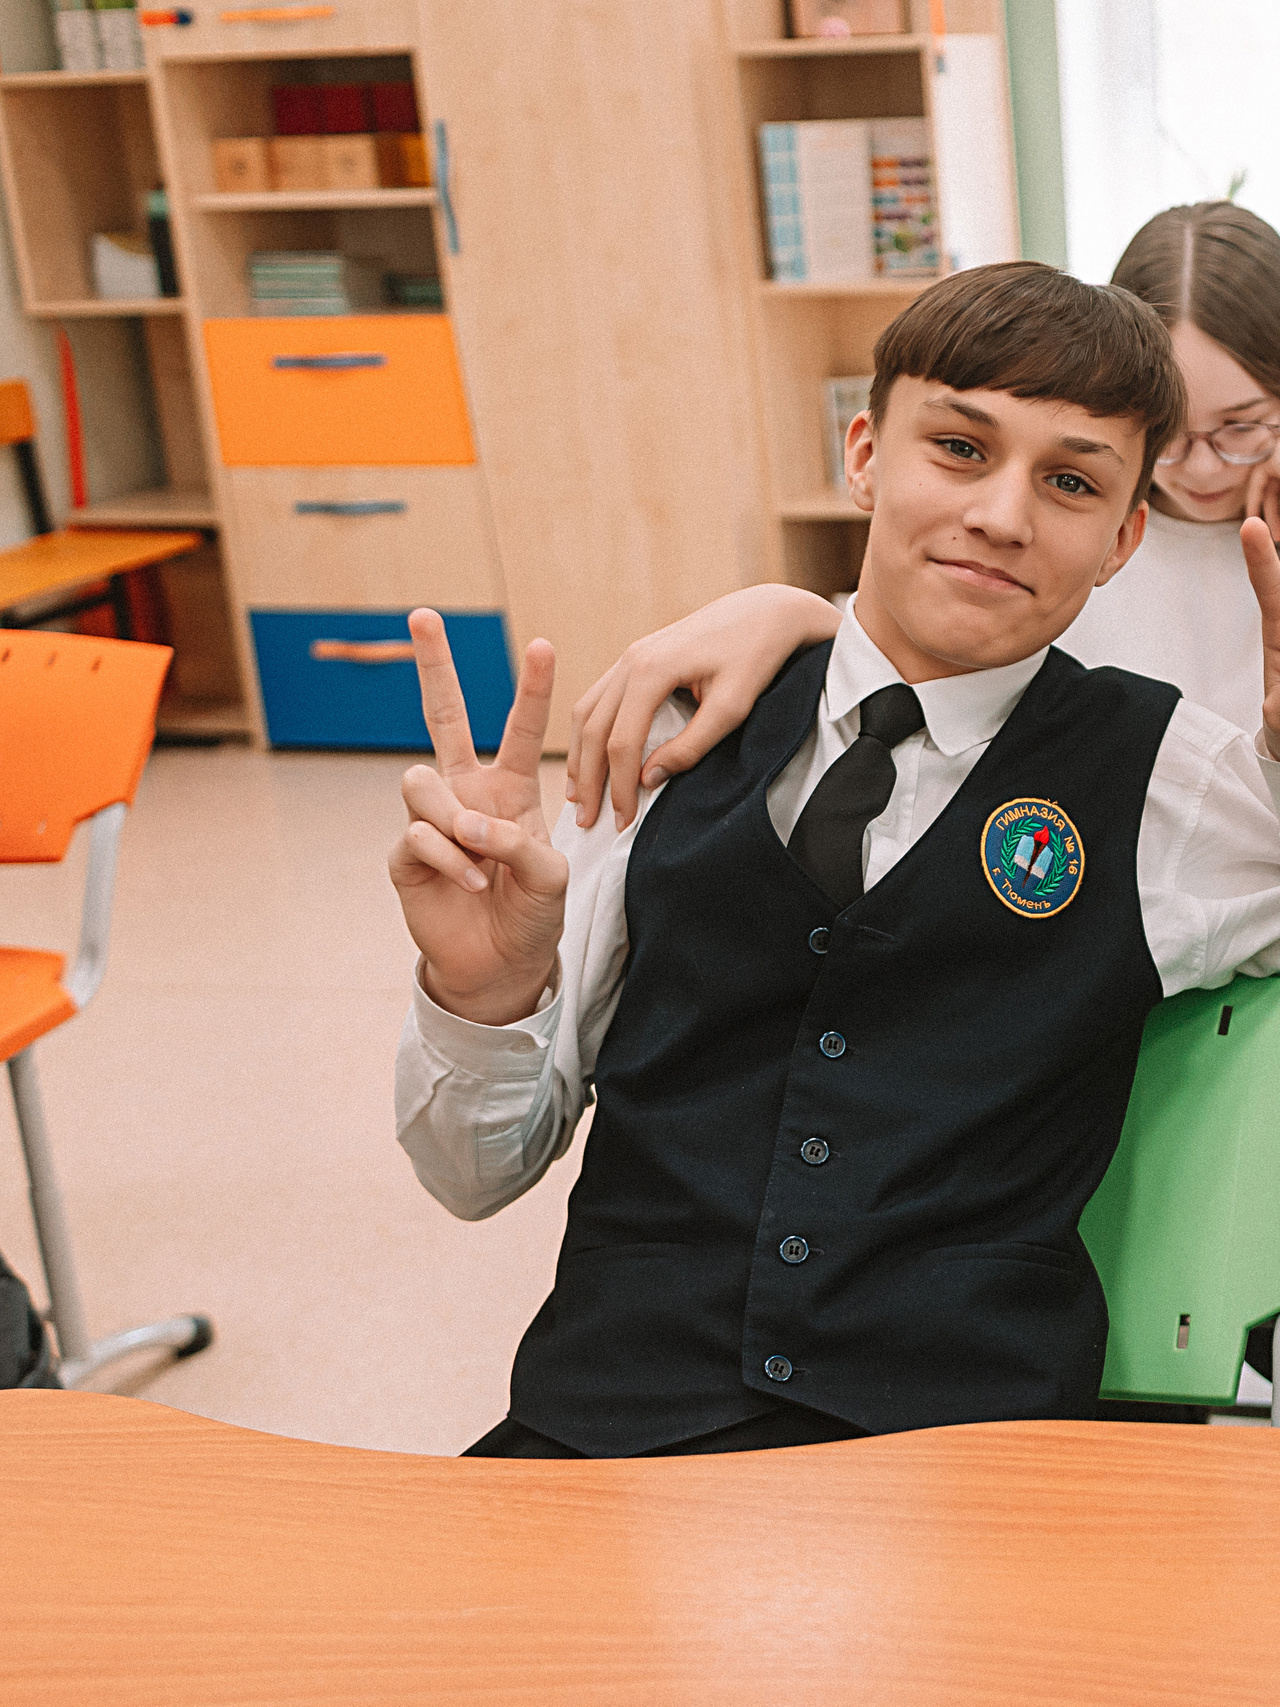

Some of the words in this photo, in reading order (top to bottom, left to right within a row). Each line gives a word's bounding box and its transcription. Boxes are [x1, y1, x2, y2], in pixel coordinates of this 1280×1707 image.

[995, 805, 1066, 832] ГИМНАЗИЯ
[1068, 859, 1079, 875] 16
[1001, 878, 1051, 910] Тюмень
